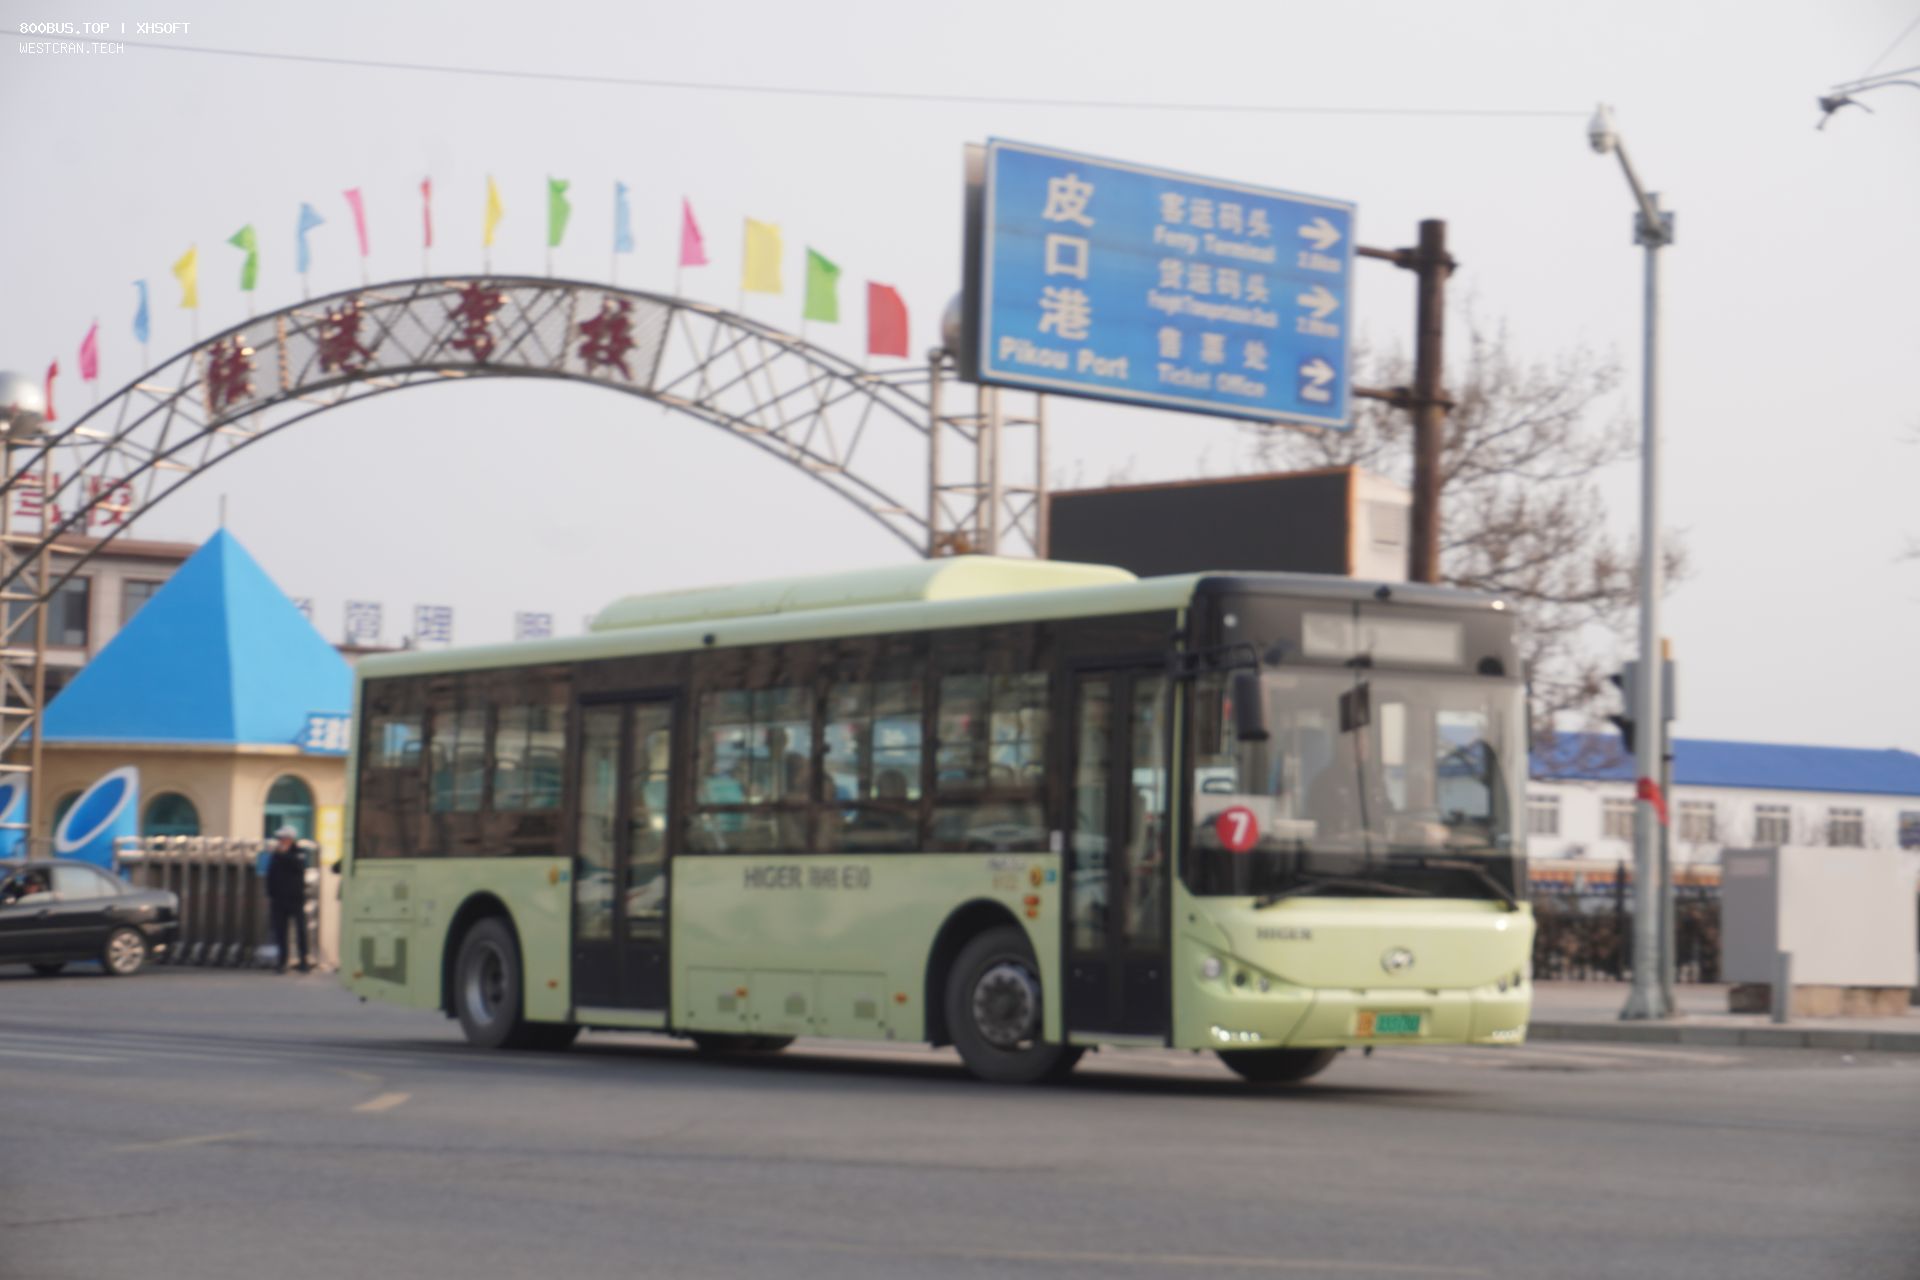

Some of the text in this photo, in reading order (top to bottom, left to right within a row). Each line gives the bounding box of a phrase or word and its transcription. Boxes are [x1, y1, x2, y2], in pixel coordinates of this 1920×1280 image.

[1160, 192, 1271, 238] 客运码头
[1038, 173, 1095, 340] 皮口港
[1154, 224, 1276, 262] Ferry Terminal
[1160, 258, 1269, 303] 货运码头
[999, 336, 1128, 380] Pikou Port
[1159, 326, 1267, 371] 售票处
[1157, 363, 1267, 398] Ticket Office
[1227, 811, 1250, 845] 7
[743, 864, 802, 889] HIGER
